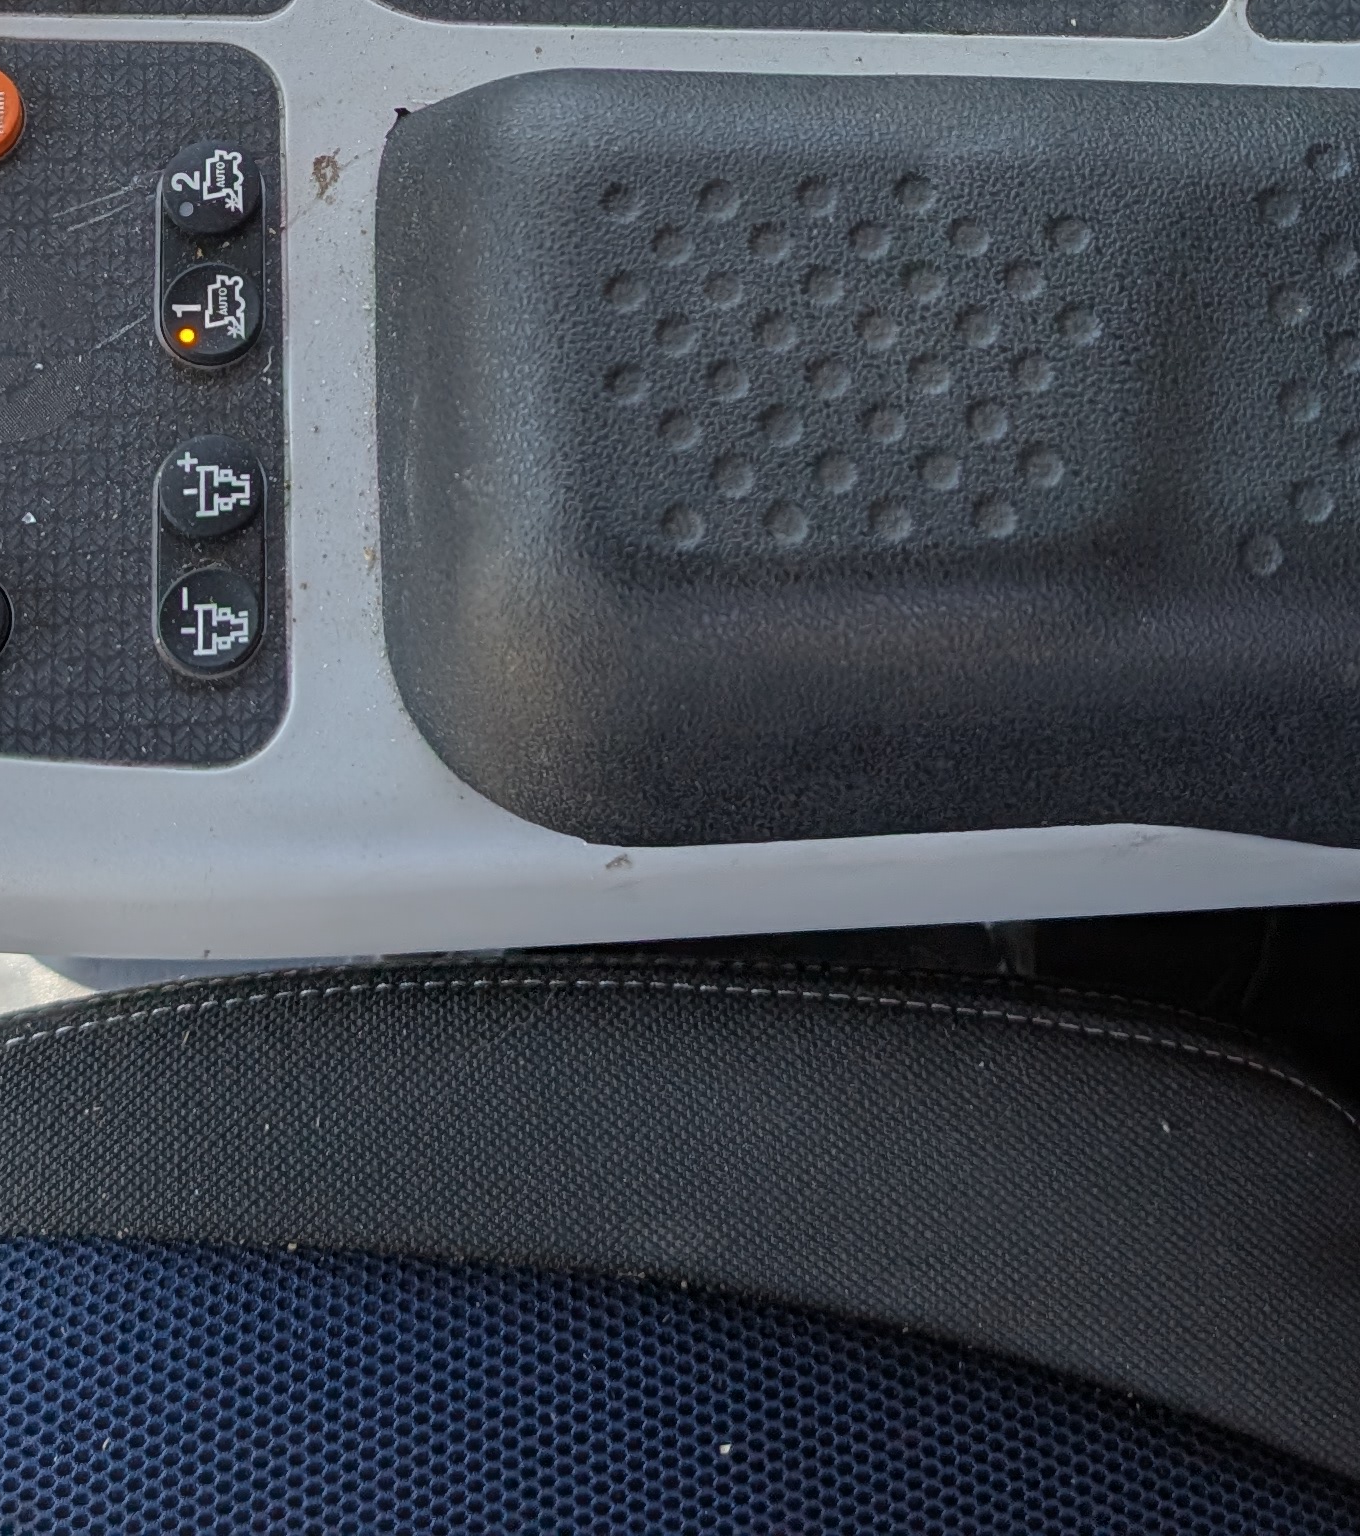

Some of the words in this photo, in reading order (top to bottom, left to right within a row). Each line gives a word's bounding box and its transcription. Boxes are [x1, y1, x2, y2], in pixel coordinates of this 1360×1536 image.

[171, 170, 201, 191] 2
[215, 161, 226, 188] AUTO
[171, 303, 202, 318] 1
[218, 287, 229, 315] AUTO
